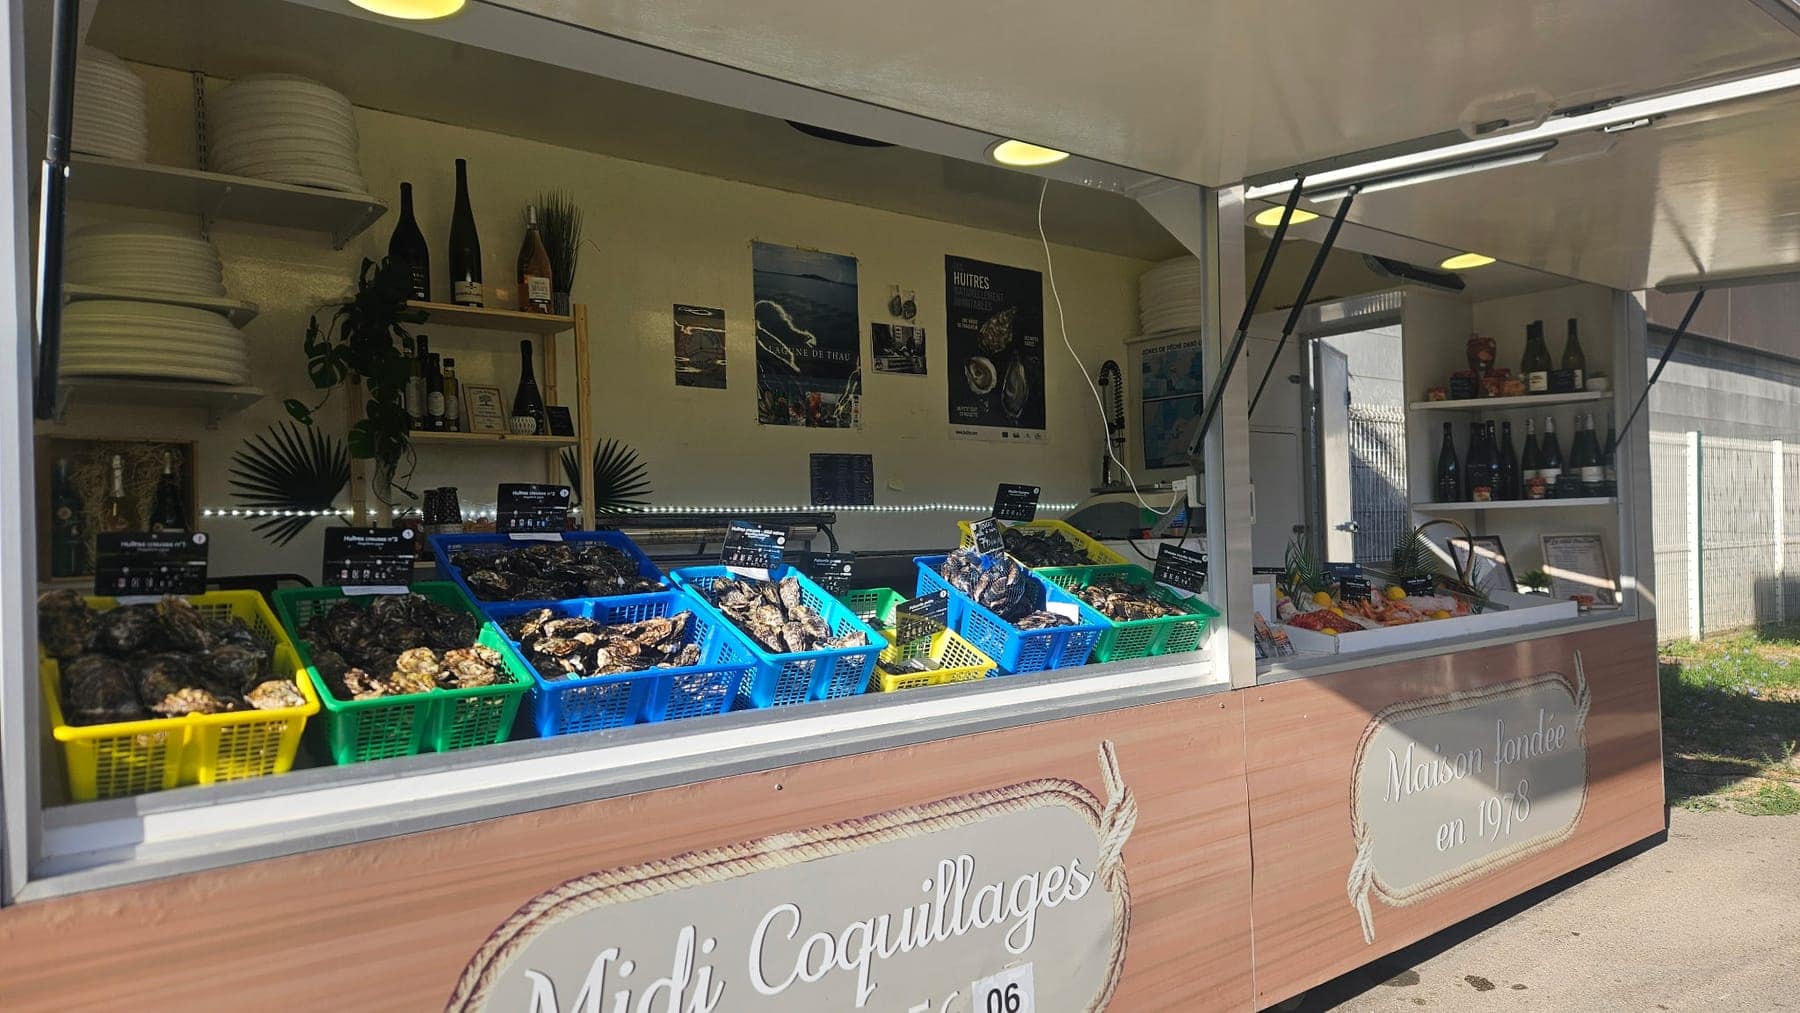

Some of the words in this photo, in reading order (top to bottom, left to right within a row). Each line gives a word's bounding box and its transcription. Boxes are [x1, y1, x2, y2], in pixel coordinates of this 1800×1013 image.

[812, 349, 824, 359] DE
[827, 351, 850, 361] THAU
[1383, 742, 1484, 803] Maison
[1494, 708, 1567, 793] fondée
[1436, 817, 1467, 851] en
[1479, 778, 1531, 843] 1978
[524, 924, 727, 1013] Midi
[748, 853, 1099, 1008] Coquillages
[986, 982, 1020, 1013] 06
